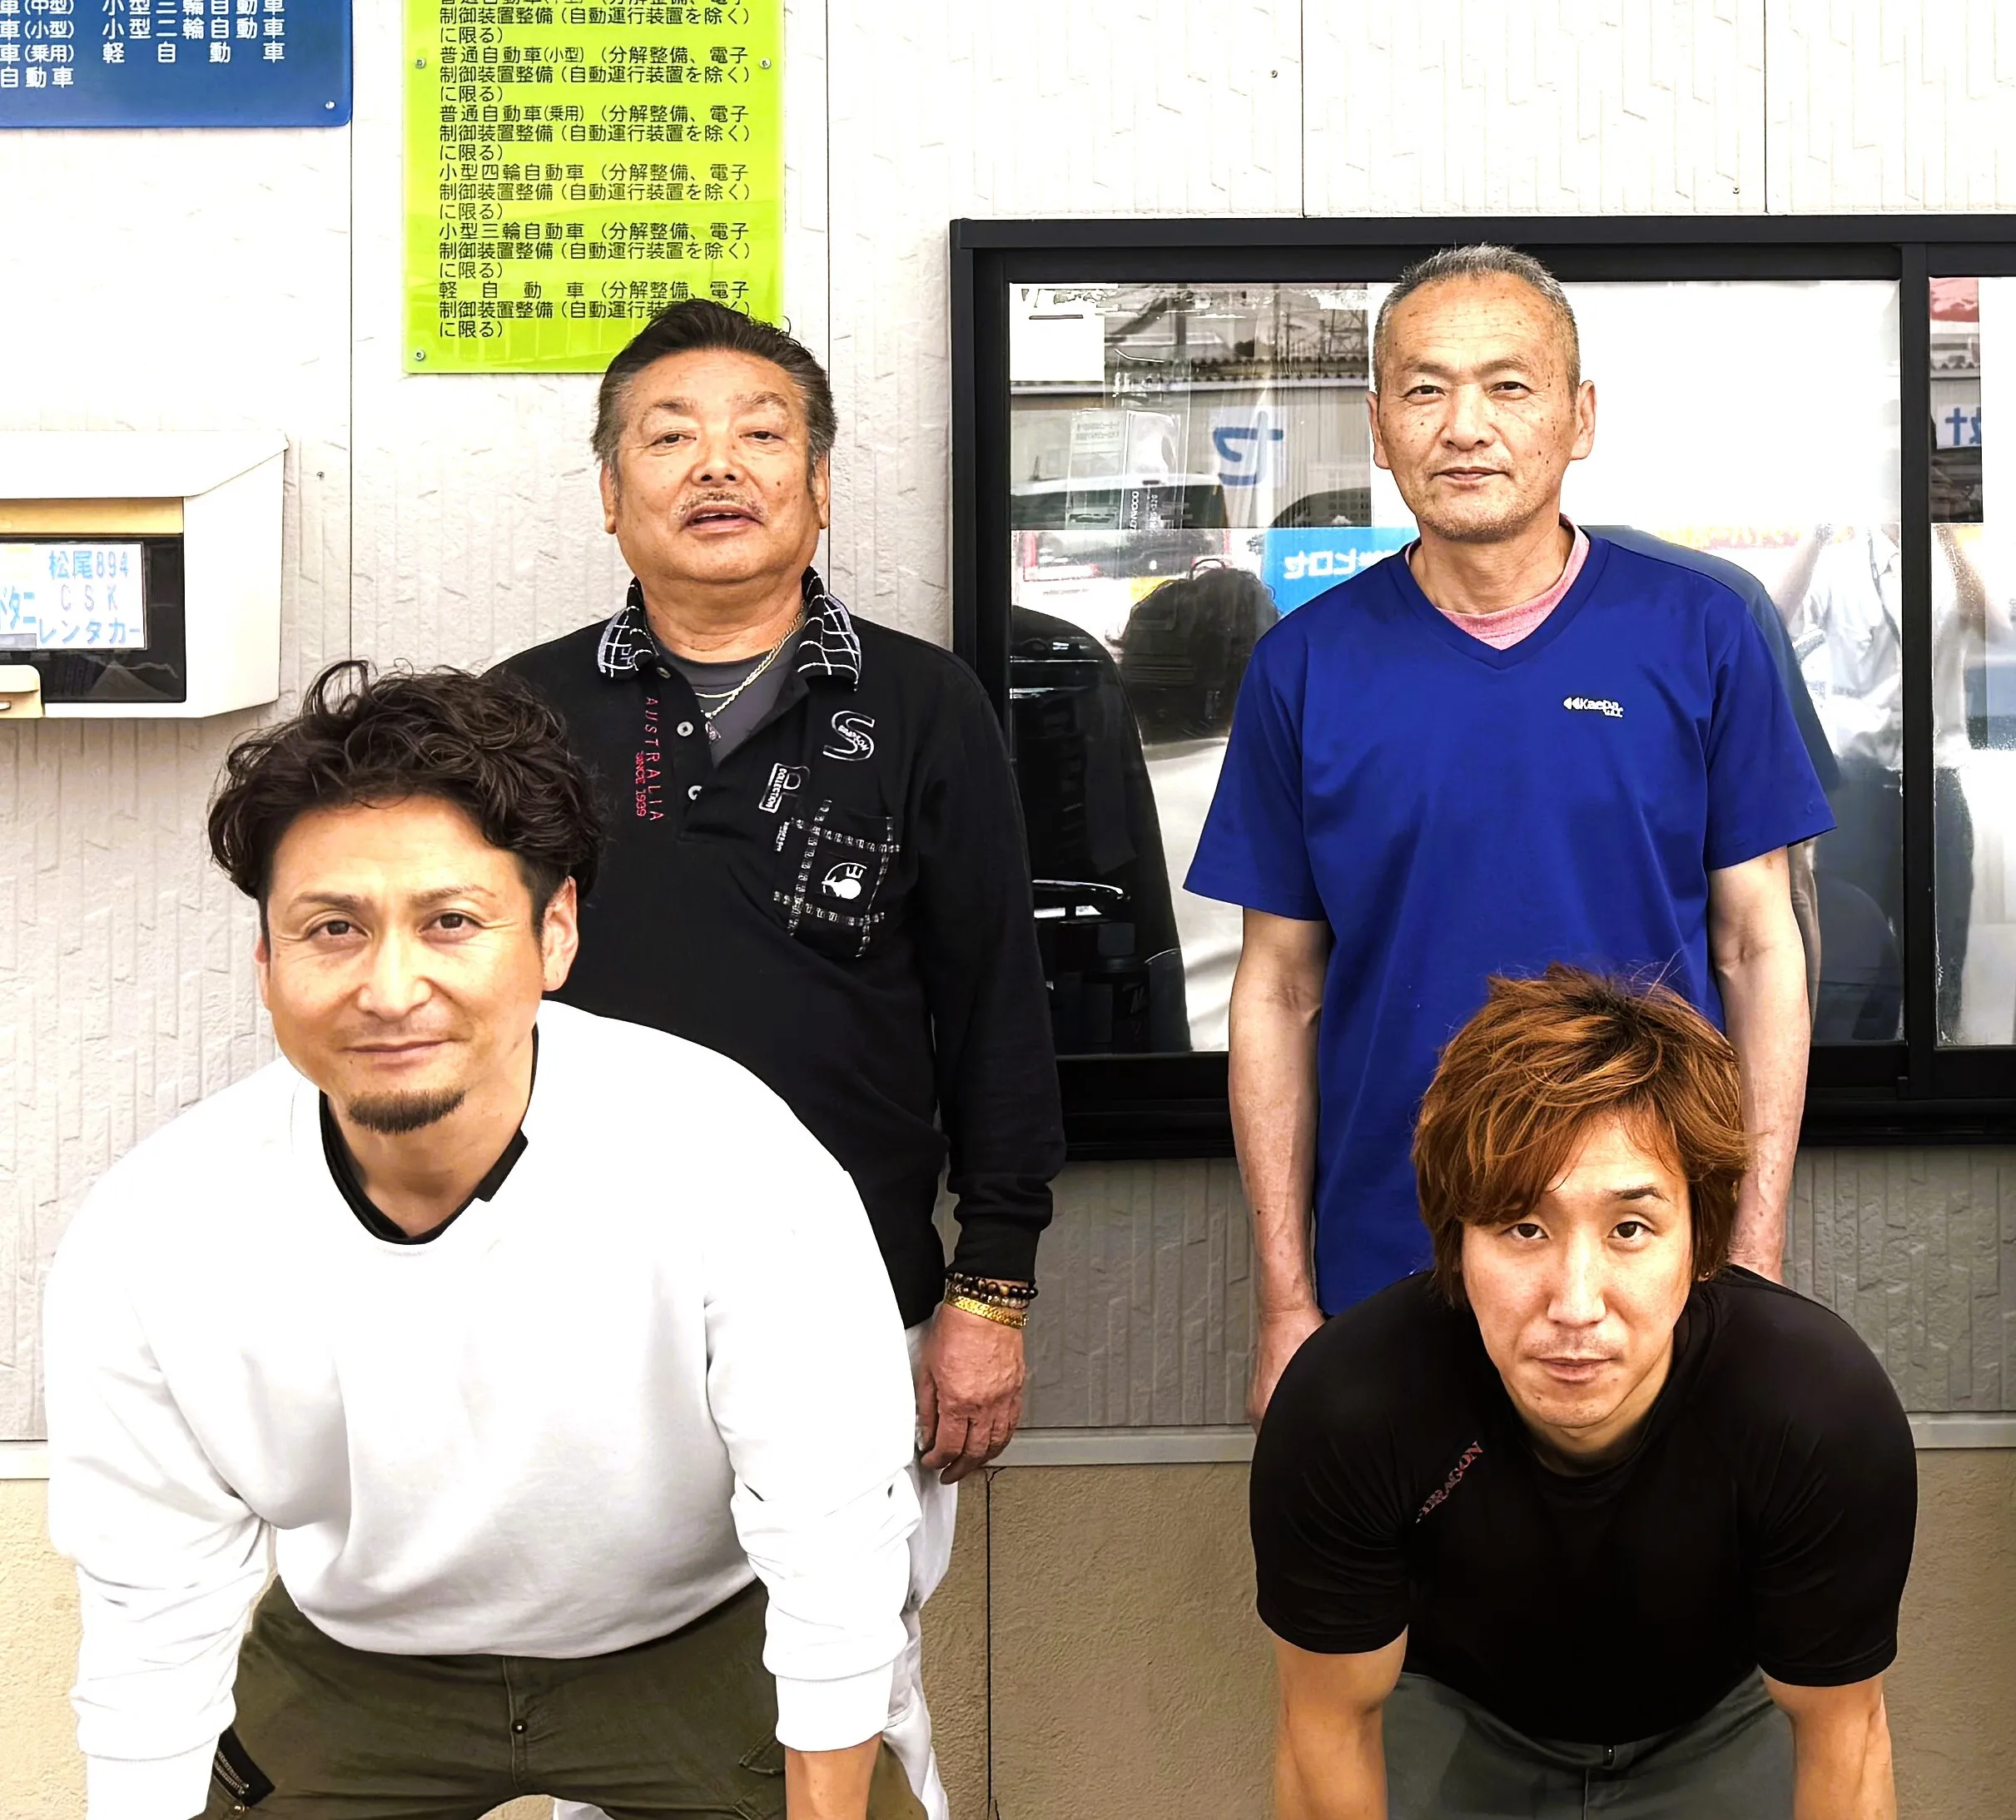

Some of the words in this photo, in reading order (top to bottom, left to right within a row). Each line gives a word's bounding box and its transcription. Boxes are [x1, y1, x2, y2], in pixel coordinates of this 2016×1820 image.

[0, 66, 74, 88] 自動車
[644, 696, 665, 821] AUSTRALIA
[635, 788, 648, 817] 1939
